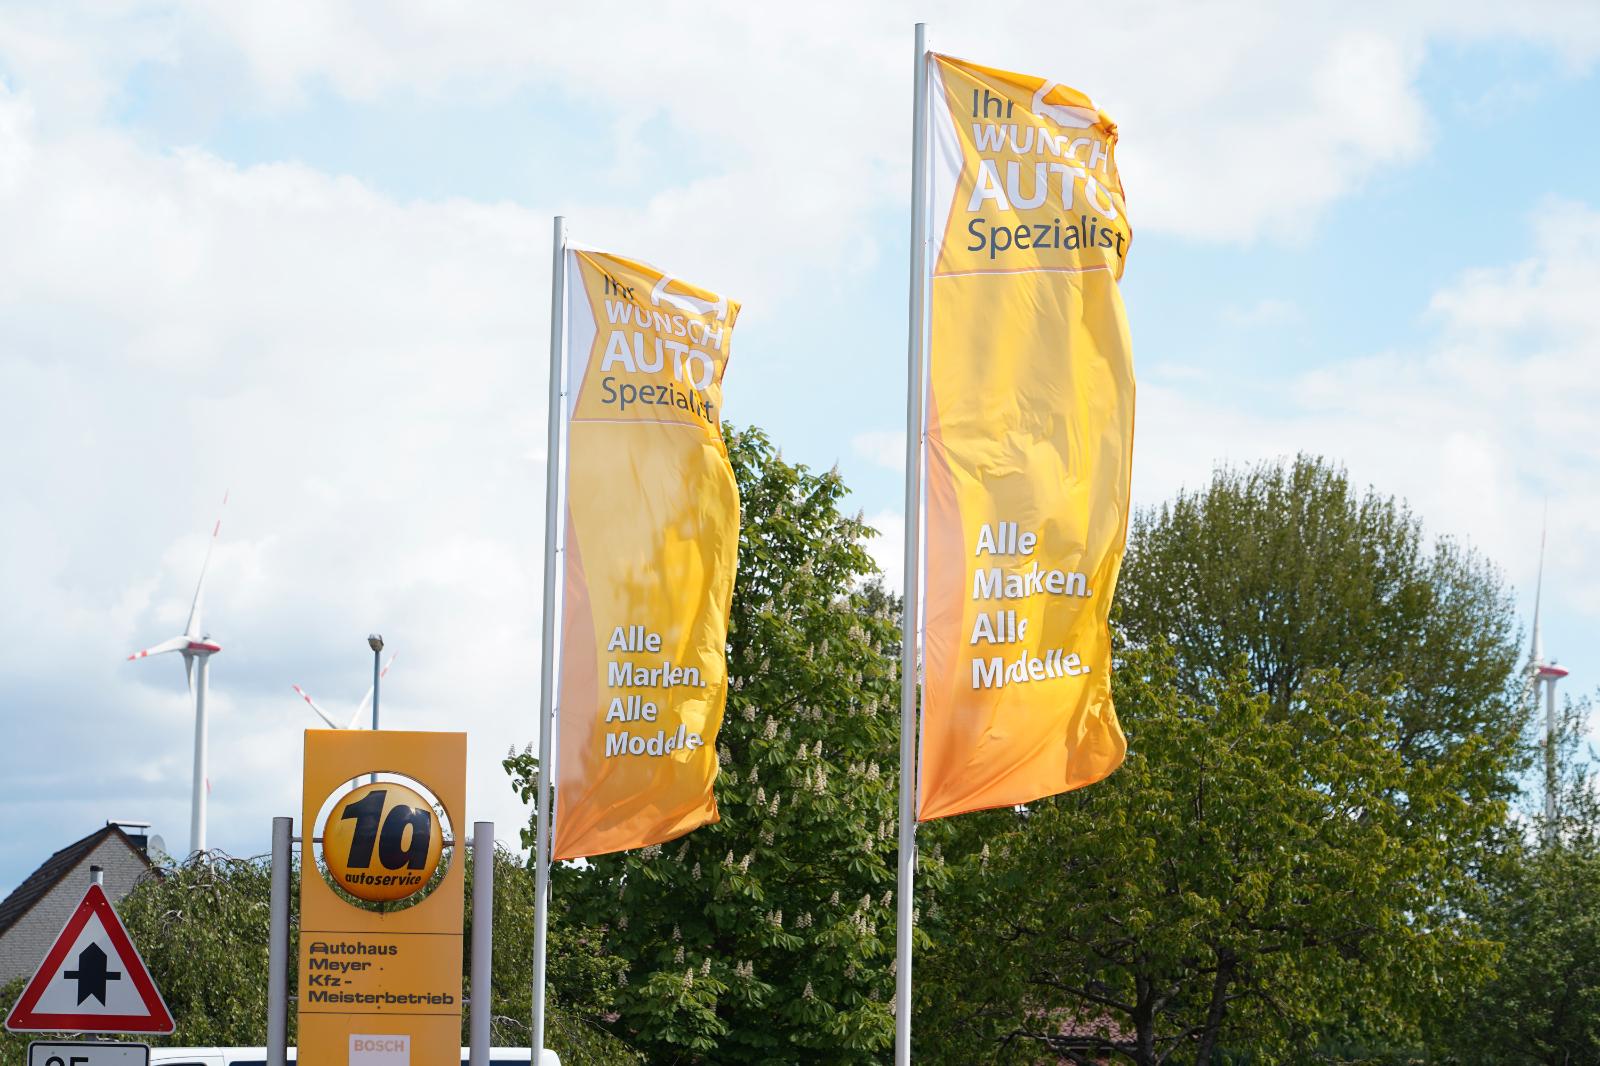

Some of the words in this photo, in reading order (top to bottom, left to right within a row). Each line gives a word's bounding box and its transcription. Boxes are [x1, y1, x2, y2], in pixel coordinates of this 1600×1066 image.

[973, 89, 1014, 118] Ihr
[972, 123, 1108, 173] WUNSCH
[967, 159, 1118, 220] AUTO
[968, 215, 1125, 259] Spezialist
[604, 275, 634, 300] Ihr
[605, 300, 724, 350] WUNSCH
[600, 330, 715, 391] AUTO
[601, 376, 714, 424] Spezialit
[975, 521, 1037, 556] Alle
[972, 561, 1093, 601] Marken.
[607, 624, 662, 652] Alle
[608, 661, 707, 688] Marken.
[605, 695, 657, 722] Alle
[341, 790, 432, 870] 1a
[345, 872, 422, 886] autoservice
[309, 942, 398, 956] Autohaus
[308, 958, 372, 974] Meyer
[308, 990, 455, 1005] Meisterbetrieb
[354, 1039, 405, 1052] BOSCH
